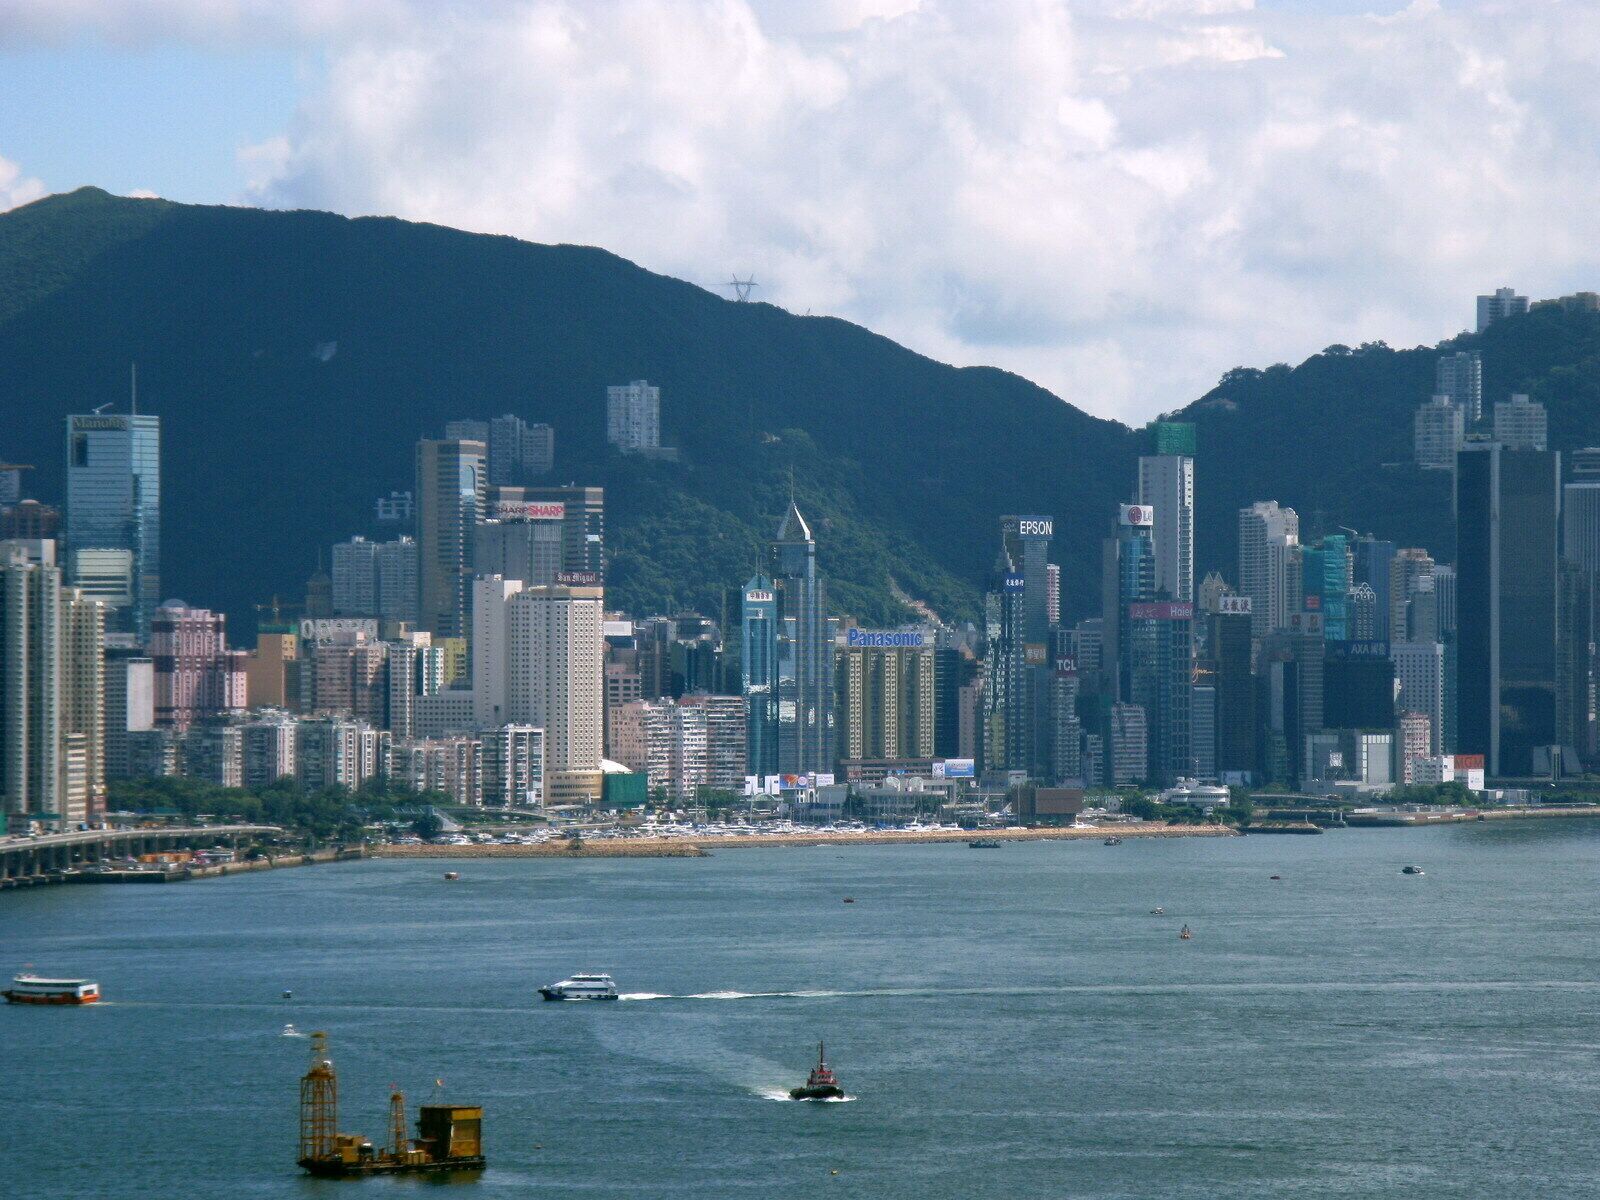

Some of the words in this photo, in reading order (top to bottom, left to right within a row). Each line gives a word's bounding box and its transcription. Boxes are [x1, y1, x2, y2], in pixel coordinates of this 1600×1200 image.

[529, 505, 565, 516] SHARP
[1020, 520, 1053, 535] EPSON
[557, 572, 571, 582] San
[572, 571, 597, 584] Miguel
[1170, 605, 1193, 617] Haier
[848, 628, 924, 647] Panasonic
[1351, 644, 1370, 655] AXA
[1056, 659, 1077, 671] TCL
[1454, 756, 1485, 769] MGM
